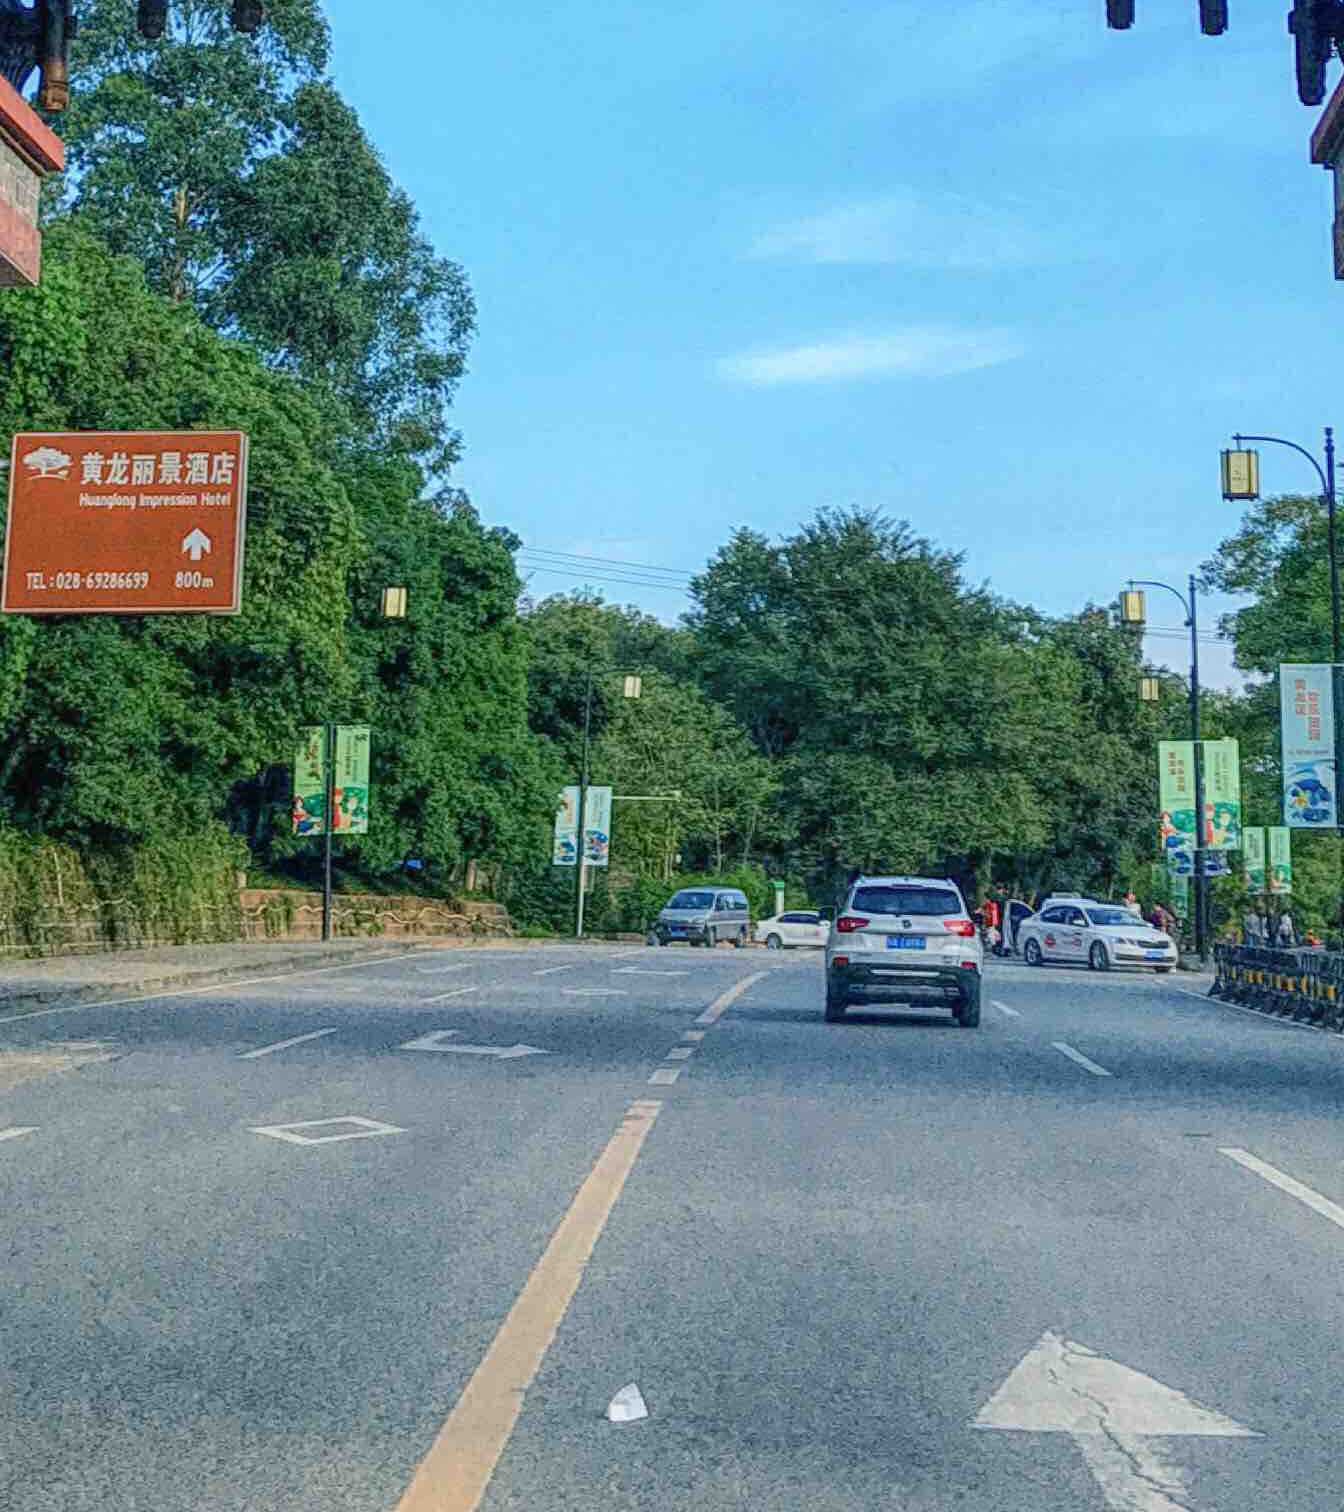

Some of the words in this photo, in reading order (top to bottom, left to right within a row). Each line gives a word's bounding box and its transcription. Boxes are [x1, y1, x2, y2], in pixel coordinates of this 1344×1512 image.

[80, 451, 236, 486] 黄龙丽景酒店
[79, 492, 137, 509] Huanglong
[140, 492, 198, 509] Impression
[201, 491, 232, 506] Hotel
